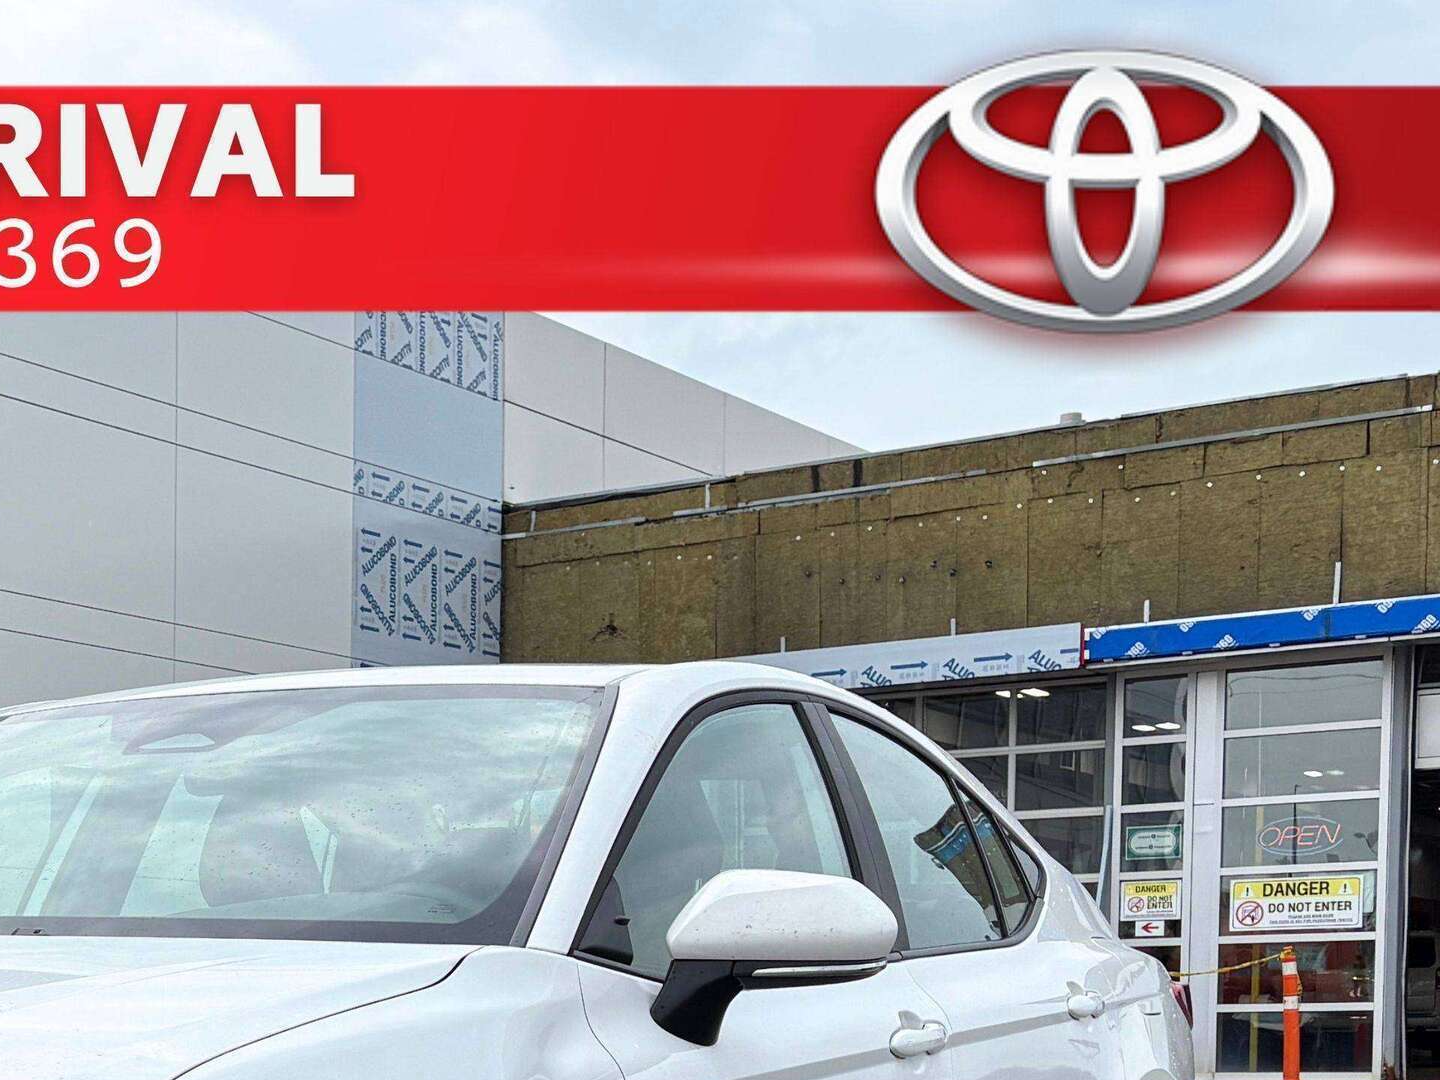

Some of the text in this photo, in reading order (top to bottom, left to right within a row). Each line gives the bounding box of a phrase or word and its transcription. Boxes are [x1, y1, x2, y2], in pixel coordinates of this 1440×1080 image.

[362, 536, 398, 577] ALUCOBOND
[404, 546, 439, 588] ALUCOBOND
[389, 553, 398, 623] ALUCOBOND
[445, 557, 478, 597] ALUCOBOND
[431, 564, 439, 632] ALUCOBOND
[470, 573, 478, 640] ALUCOBOND
[1260, 824, 1341, 846] OPEN
[1135, 885, 1166, 893] DANGER
[1263, 881, 1330, 897] DANGER
[1268, 901, 1352, 913] DO NOT ENTER
